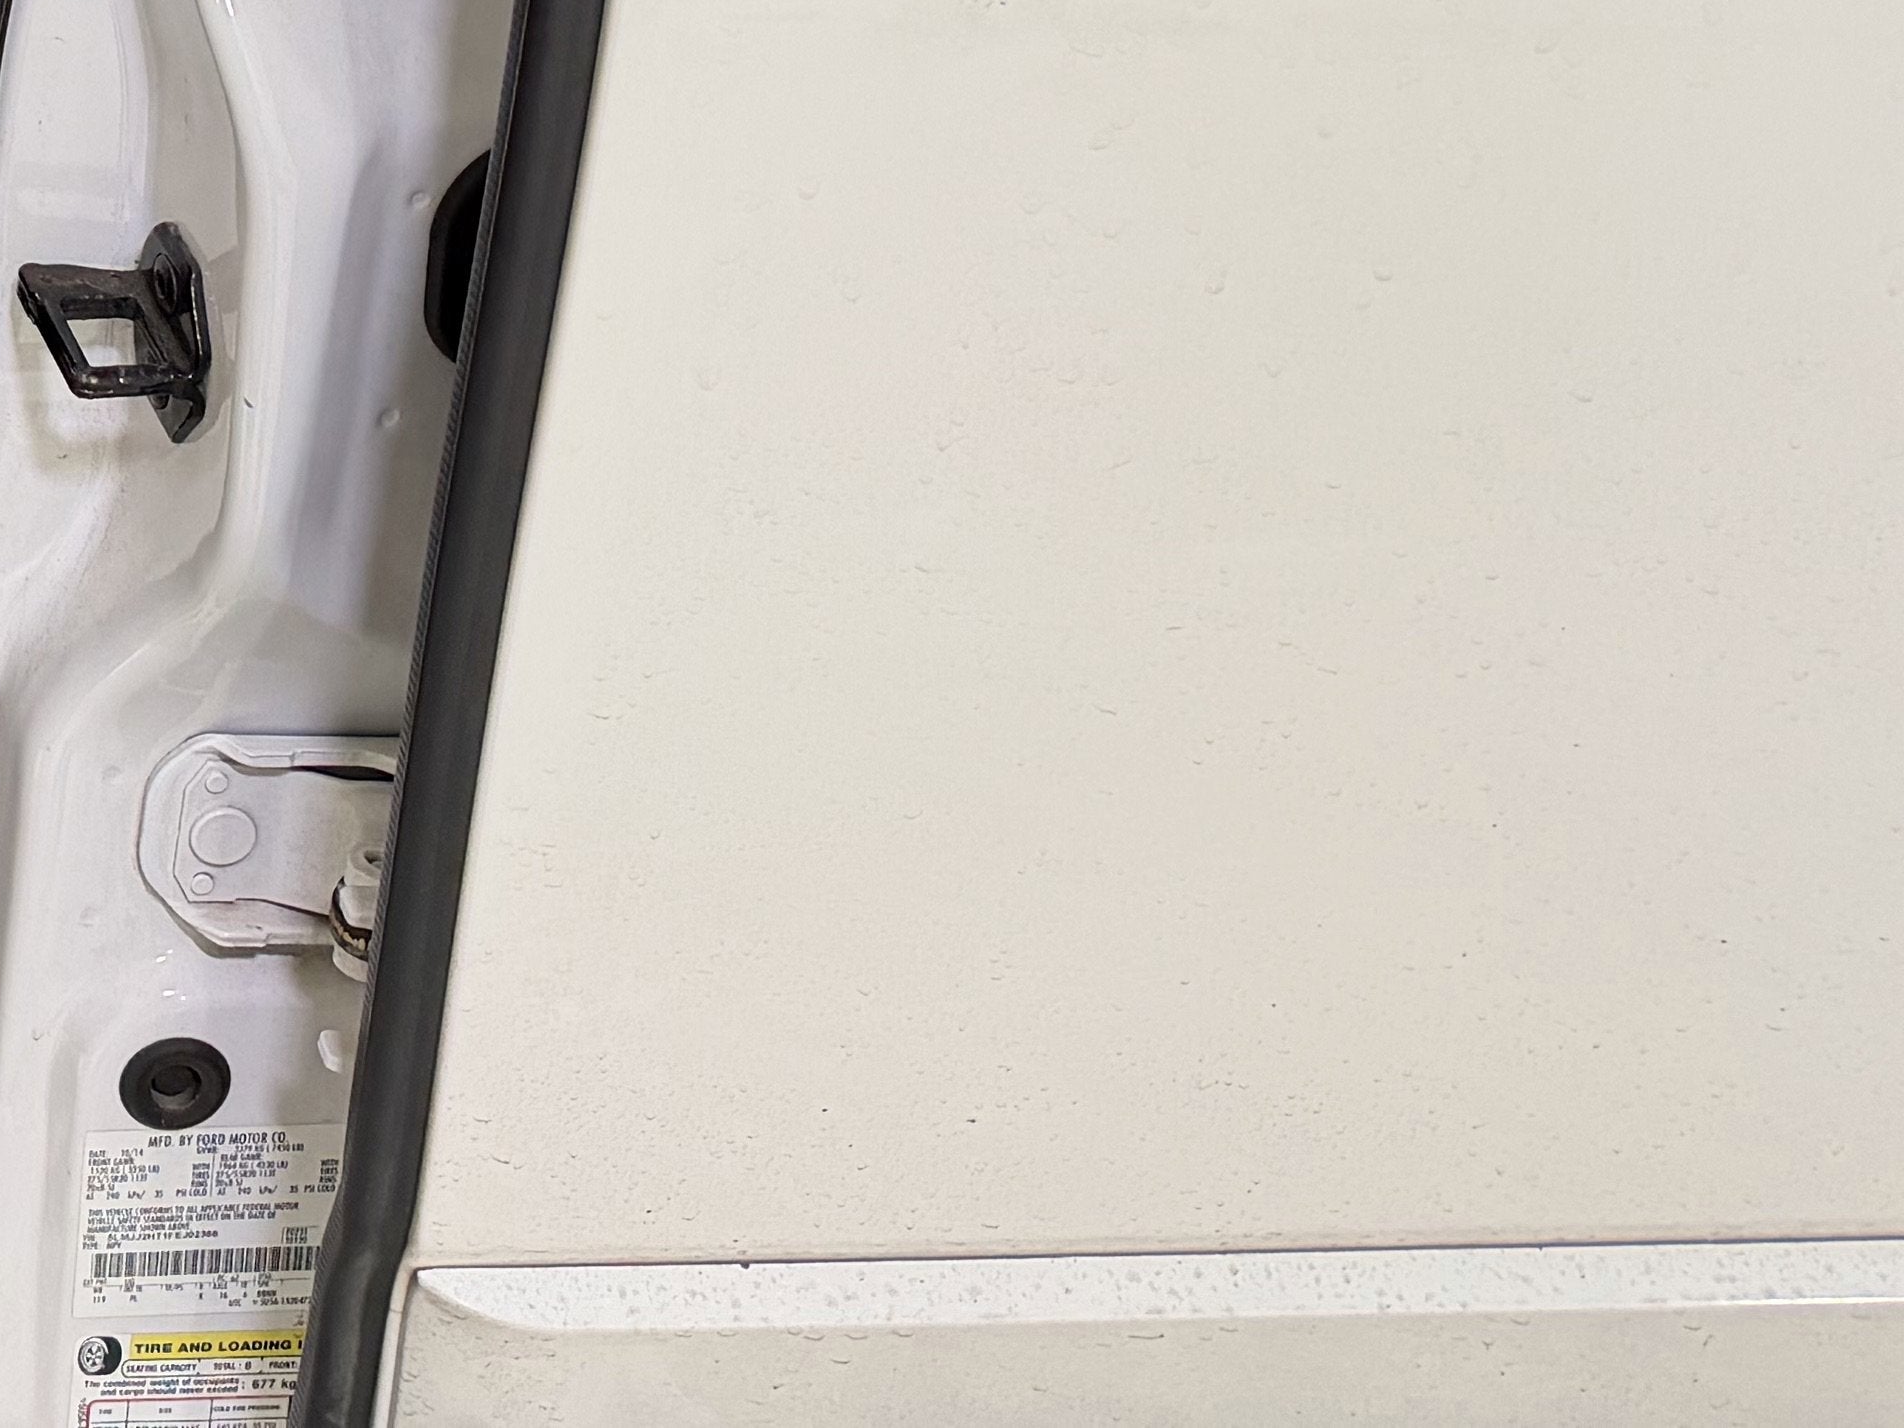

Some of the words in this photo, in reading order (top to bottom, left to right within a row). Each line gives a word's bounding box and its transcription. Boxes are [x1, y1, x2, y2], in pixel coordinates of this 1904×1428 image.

[179, 1134, 193, 1146] BY
[196, 1133, 226, 1145] FORD
[229, 1132, 268, 1144] MOTOR
[134, 1343, 173, 1354] TIRE
[178, 1342, 213, 1353] AND
[218, 1340, 291, 1351] LOADING
[126, 1363, 157, 1373] SEATING
[160, 1362, 197, 1372] CAPACITY
[85, 1380, 100, 1388] The
[103, 1379, 146, 1388] combined
[149, 1379, 179, 1388] weight
[182, 1378, 191, 1386] of
[251, 1379, 276, 1390] 677
[100, 1389, 116, 1397] and
[119, 1389, 144, 1398] cargo
[147, 1387, 176, 1396] should
